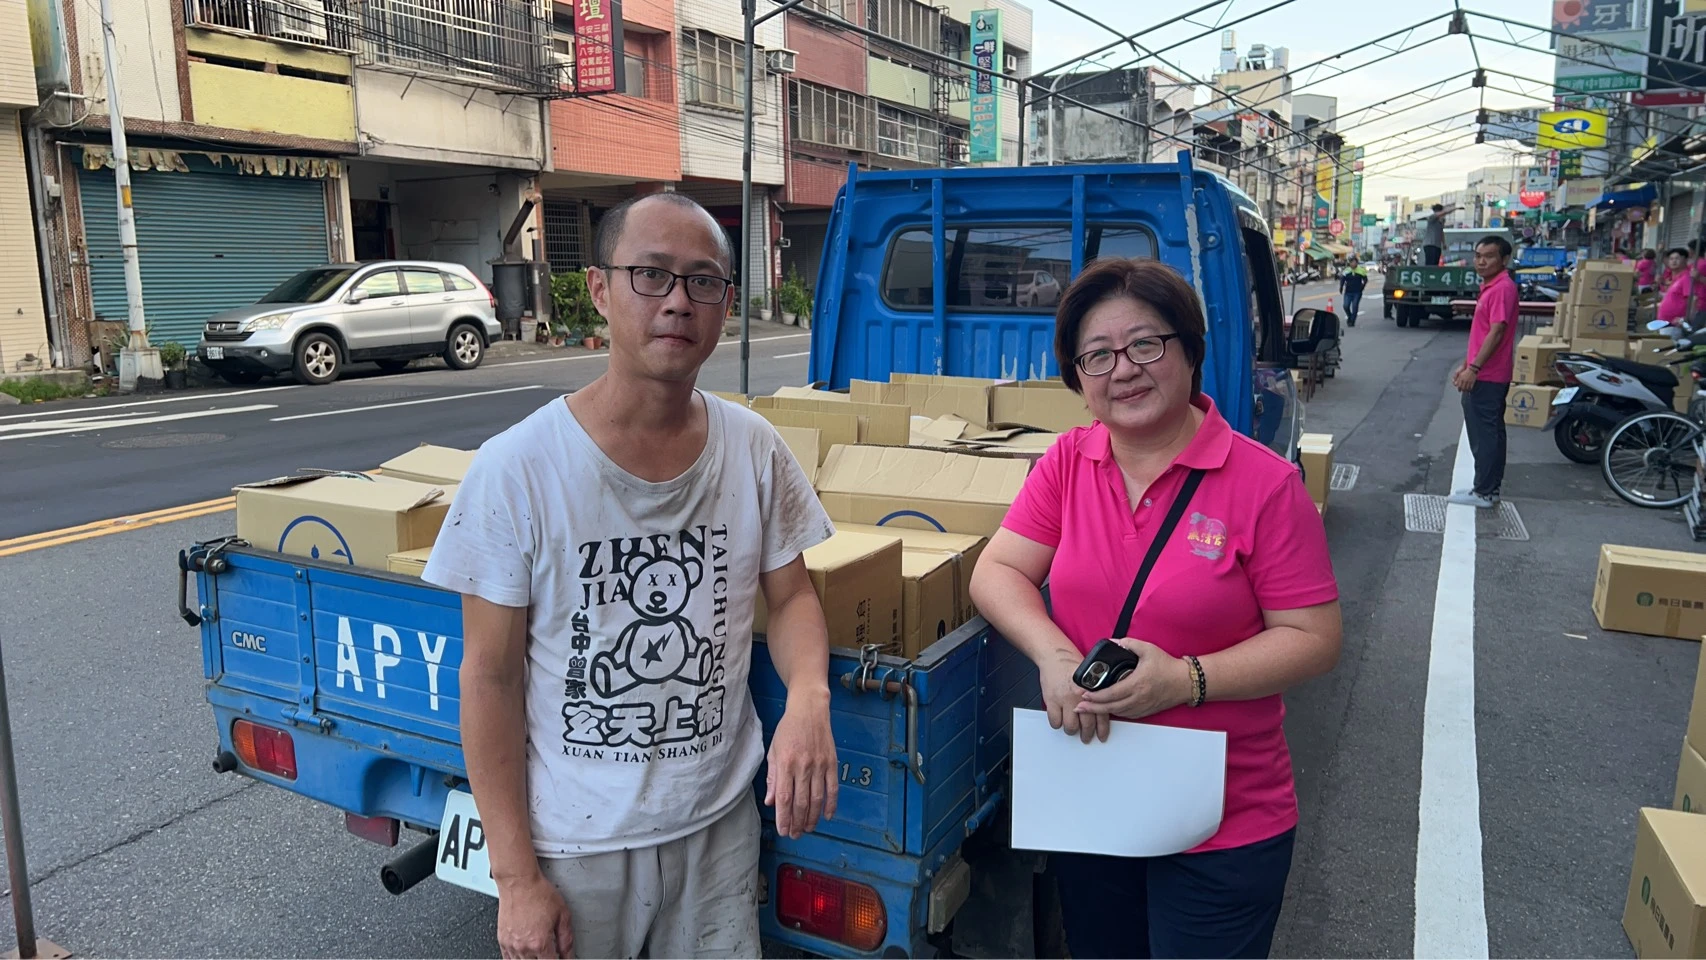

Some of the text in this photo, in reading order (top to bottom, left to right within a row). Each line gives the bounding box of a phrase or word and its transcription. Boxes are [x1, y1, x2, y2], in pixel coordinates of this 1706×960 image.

[578, 525, 708, 579] ZHEN
[580, 577, 629, 610] JIA
[711, 524, 728, 684] TAICHUNG
[231, 630, 267, 653] CMC
[336, 615, 447, 712] APY
[561, 684, 726, 748] 玄天上帝
[562, 731, 723, 764] XUAN TIAN SHANG DI
[440, 813, 493, 880] AP
